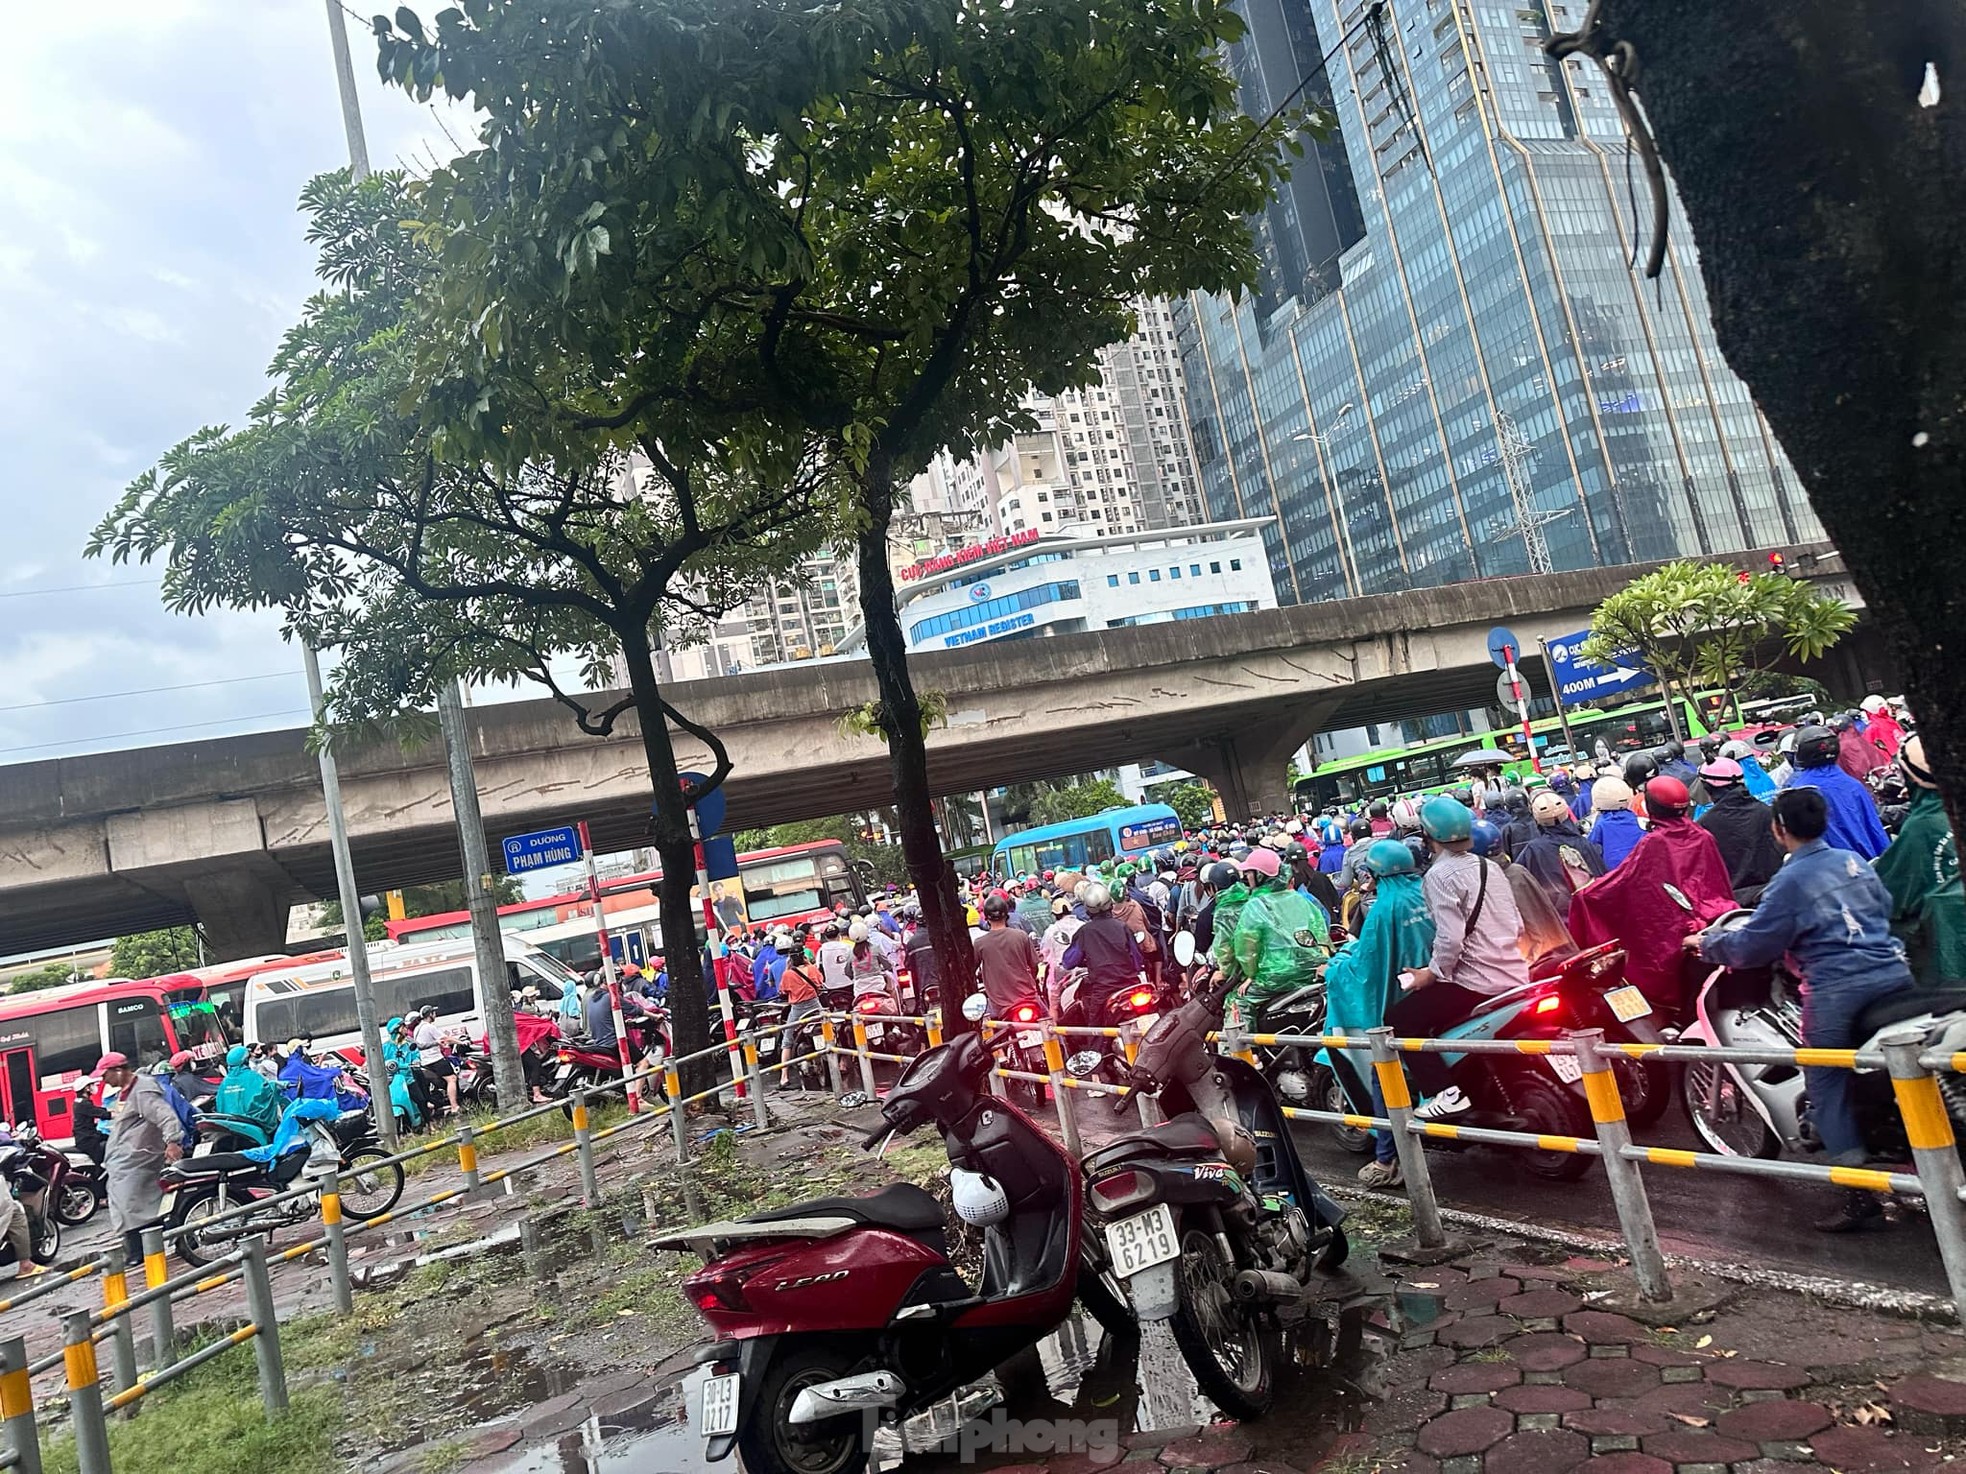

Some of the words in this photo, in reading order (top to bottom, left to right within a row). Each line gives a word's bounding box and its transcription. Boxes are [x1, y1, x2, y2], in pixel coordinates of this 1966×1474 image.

[1011, 527, 1040, 547] NAM
[944, 626, 988, 648] VIETNAM
[988, 612, 1036, 636] REGISTER
[1562, 677, 1596, 695] 400M
[512, 851, 545, 869] PHẠM
[1193, 1165, 1225, 1180] Viva
[1115, 1209, 1165, 1248] 33-M3
[1122, 1232, 1171, 1270] 6219
[774, 1268, 850, 1292] LEAD
